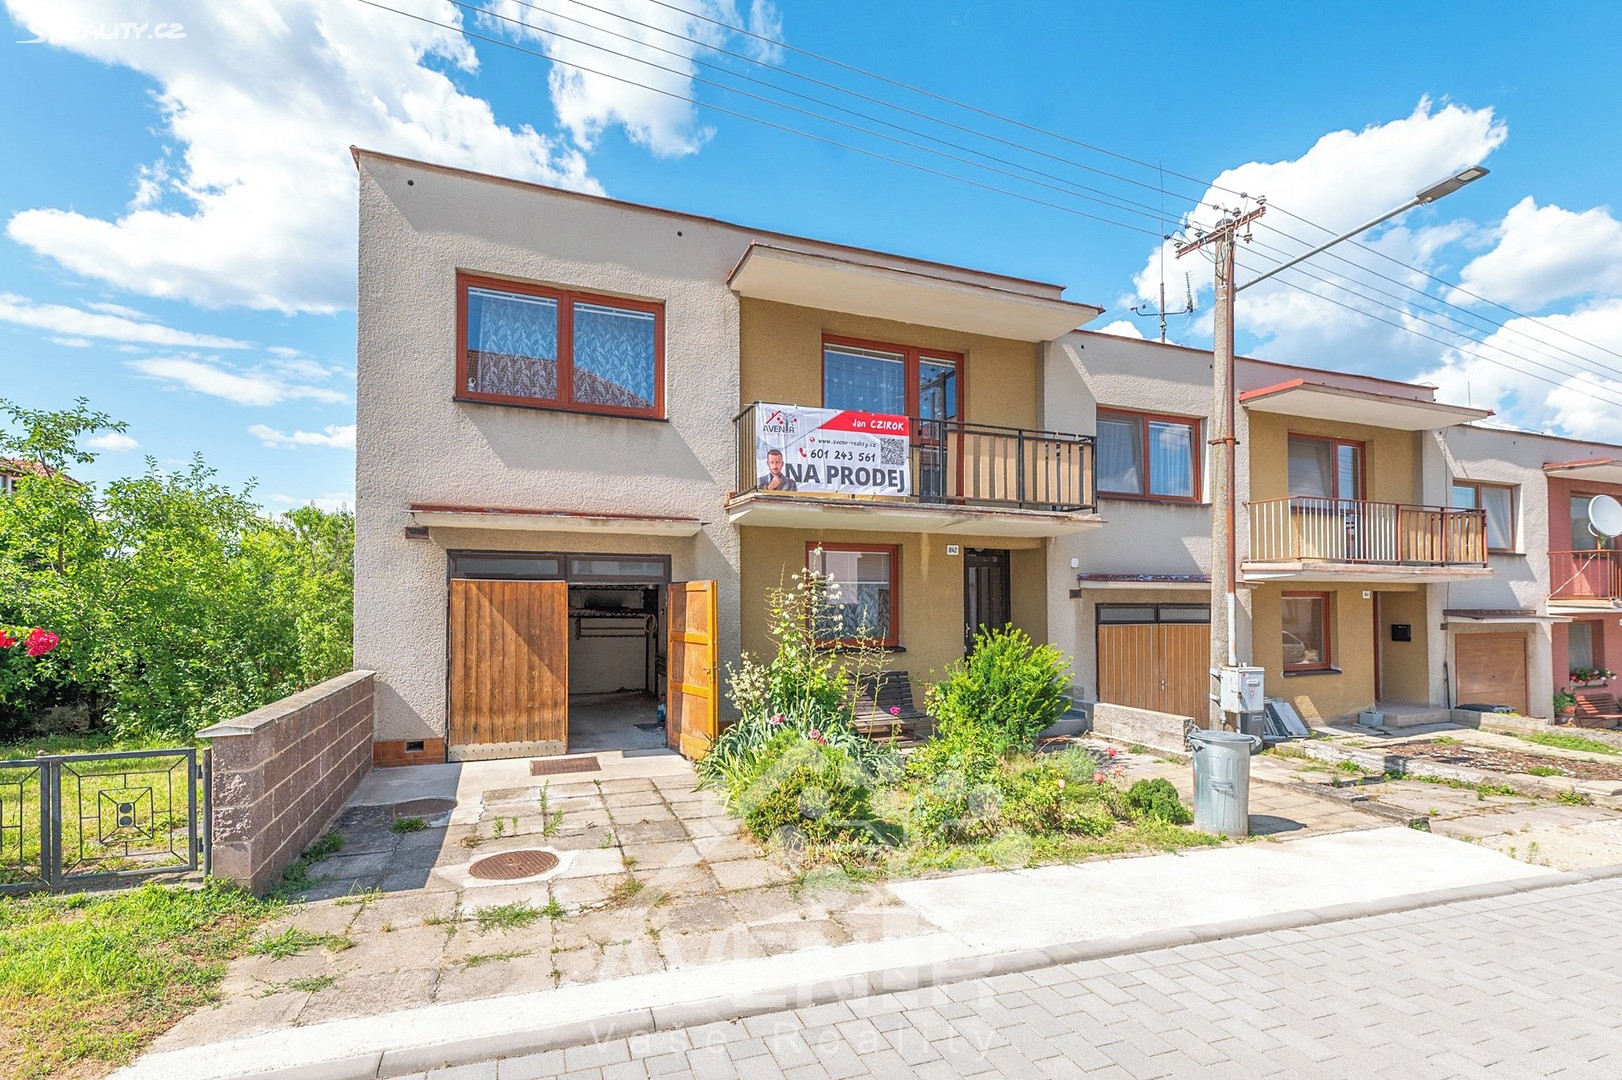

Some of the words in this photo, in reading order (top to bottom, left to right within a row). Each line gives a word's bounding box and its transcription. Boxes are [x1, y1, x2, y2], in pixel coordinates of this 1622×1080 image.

[851, 418, 867, 428] Jan
[870, 420, 905, 431] CZIROK
[810, 449, 829, 460] 601
[834, 450, 854, 461] 243
[858, 452, 876, 463] 561
[785, 462, 821, 484] NA
[826, 465, 905, 493] PRODEJ
